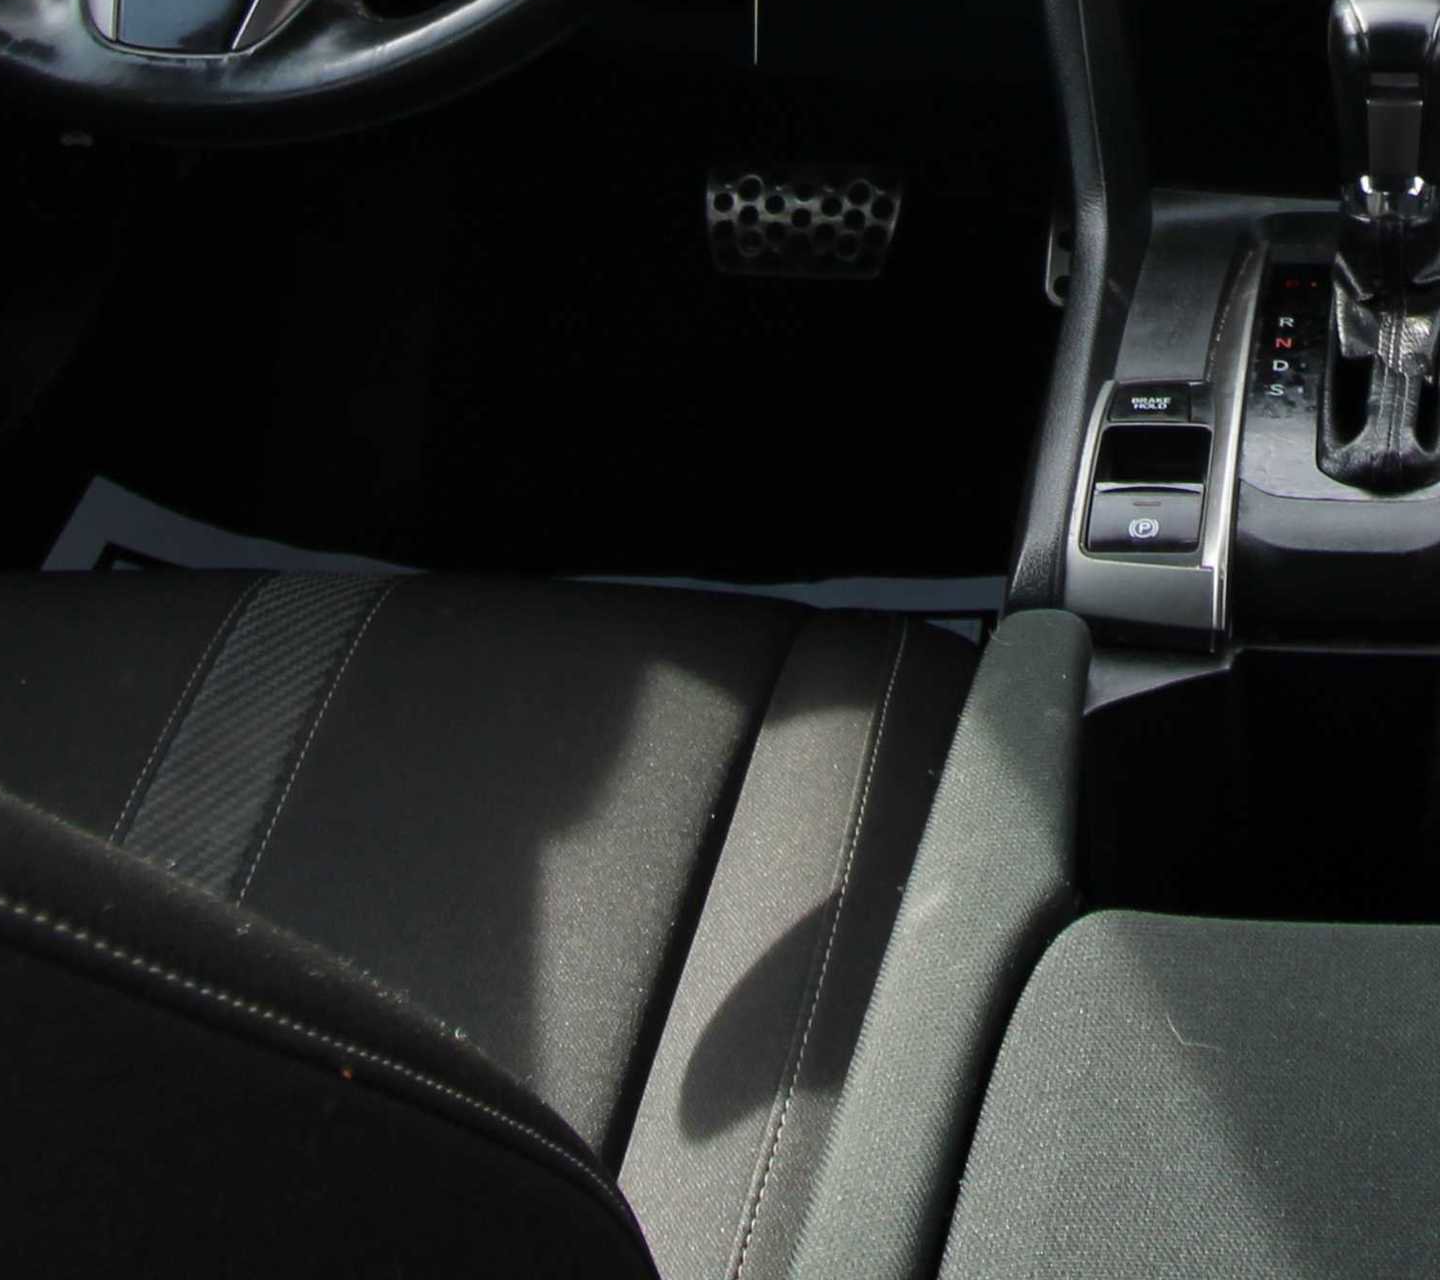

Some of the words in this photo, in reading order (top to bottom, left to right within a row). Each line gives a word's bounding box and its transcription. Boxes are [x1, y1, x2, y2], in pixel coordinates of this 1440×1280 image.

[1278, 317, 1295, 328] R
[1275, 337, 1292, 349] N
[1272, 359, 1289, 372] D
[1269, 383, 1285, 397] S
[1131, 396, 1172, 405] BRAKE
